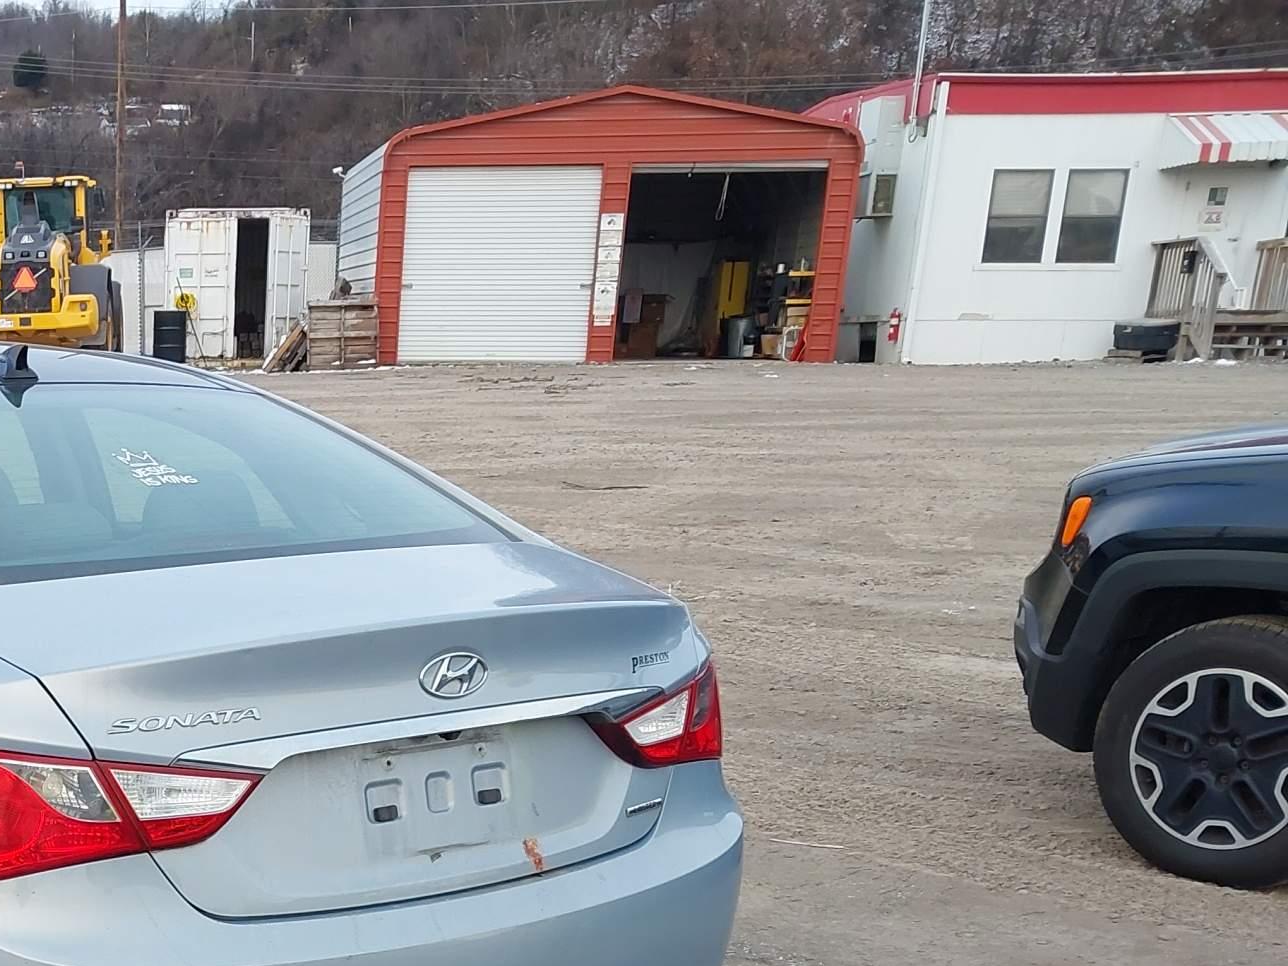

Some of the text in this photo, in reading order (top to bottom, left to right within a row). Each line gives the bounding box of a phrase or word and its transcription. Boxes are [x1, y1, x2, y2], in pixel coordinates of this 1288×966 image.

[132, 465, 176, 478] JESUS
[140, 474, 199, 487] IS KING
[631, 651, 670, 674] PRESTON
[107, 707, 261, 735] SONATA
